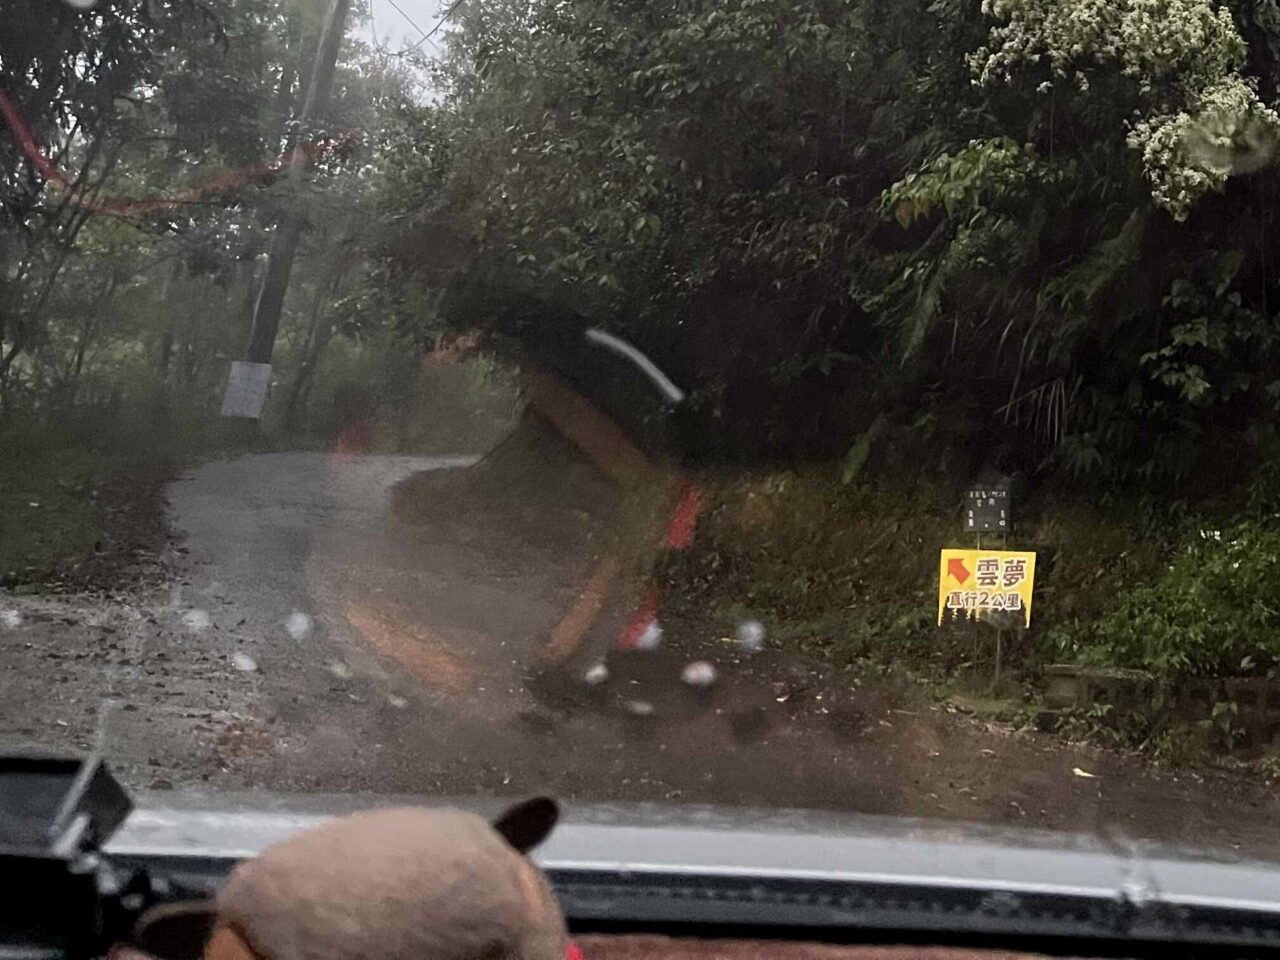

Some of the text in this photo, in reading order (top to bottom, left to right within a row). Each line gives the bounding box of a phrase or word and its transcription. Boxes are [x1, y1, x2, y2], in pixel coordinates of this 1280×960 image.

[977, 558, 1026, 587] 雲夢
[949, 591, 1019, 609] 直行2公里
